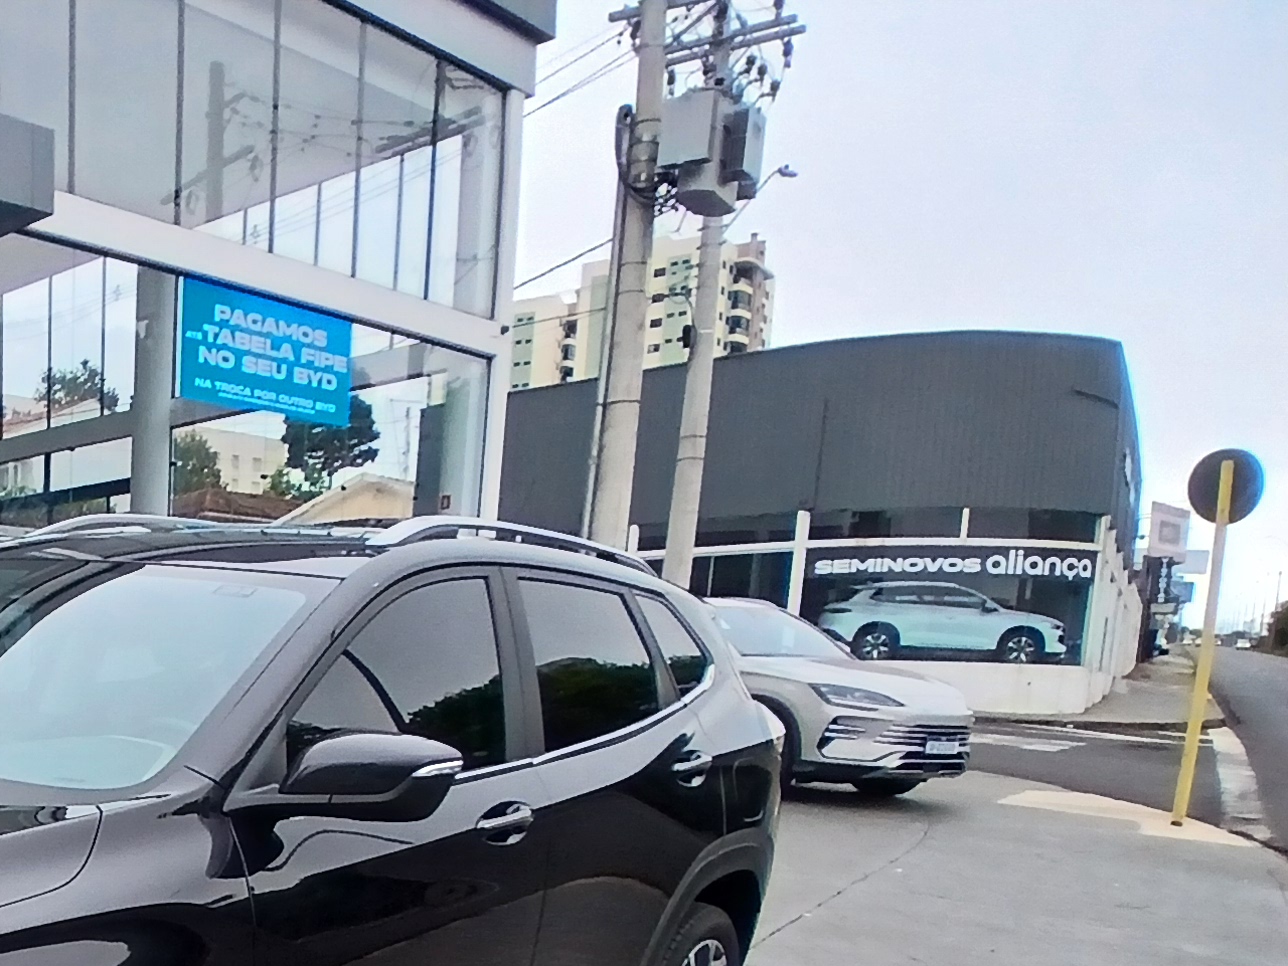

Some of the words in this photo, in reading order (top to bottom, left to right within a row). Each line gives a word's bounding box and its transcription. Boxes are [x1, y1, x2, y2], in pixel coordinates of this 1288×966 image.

[203, 323, 295, 362] TABELA
[301, 347, 348, 373] FIPE
[214, 304, 328, 348] PAGAMOS
[198, 345, 235, 369] NO
[241, 355, 288, 380] SEU
[293, 366, 338, 391] BYD
[194, 377, 211, 389] NA
[214, 381, 252, 397] TROCA
[254, 388, 277, 401] POR
[278, 393, 314, 409] OUTRO
[316, 402, 336, 413] BYD
[814, 557, 981, 575] SEMINOVOS
[985, 549, 1092, 581] aliança
